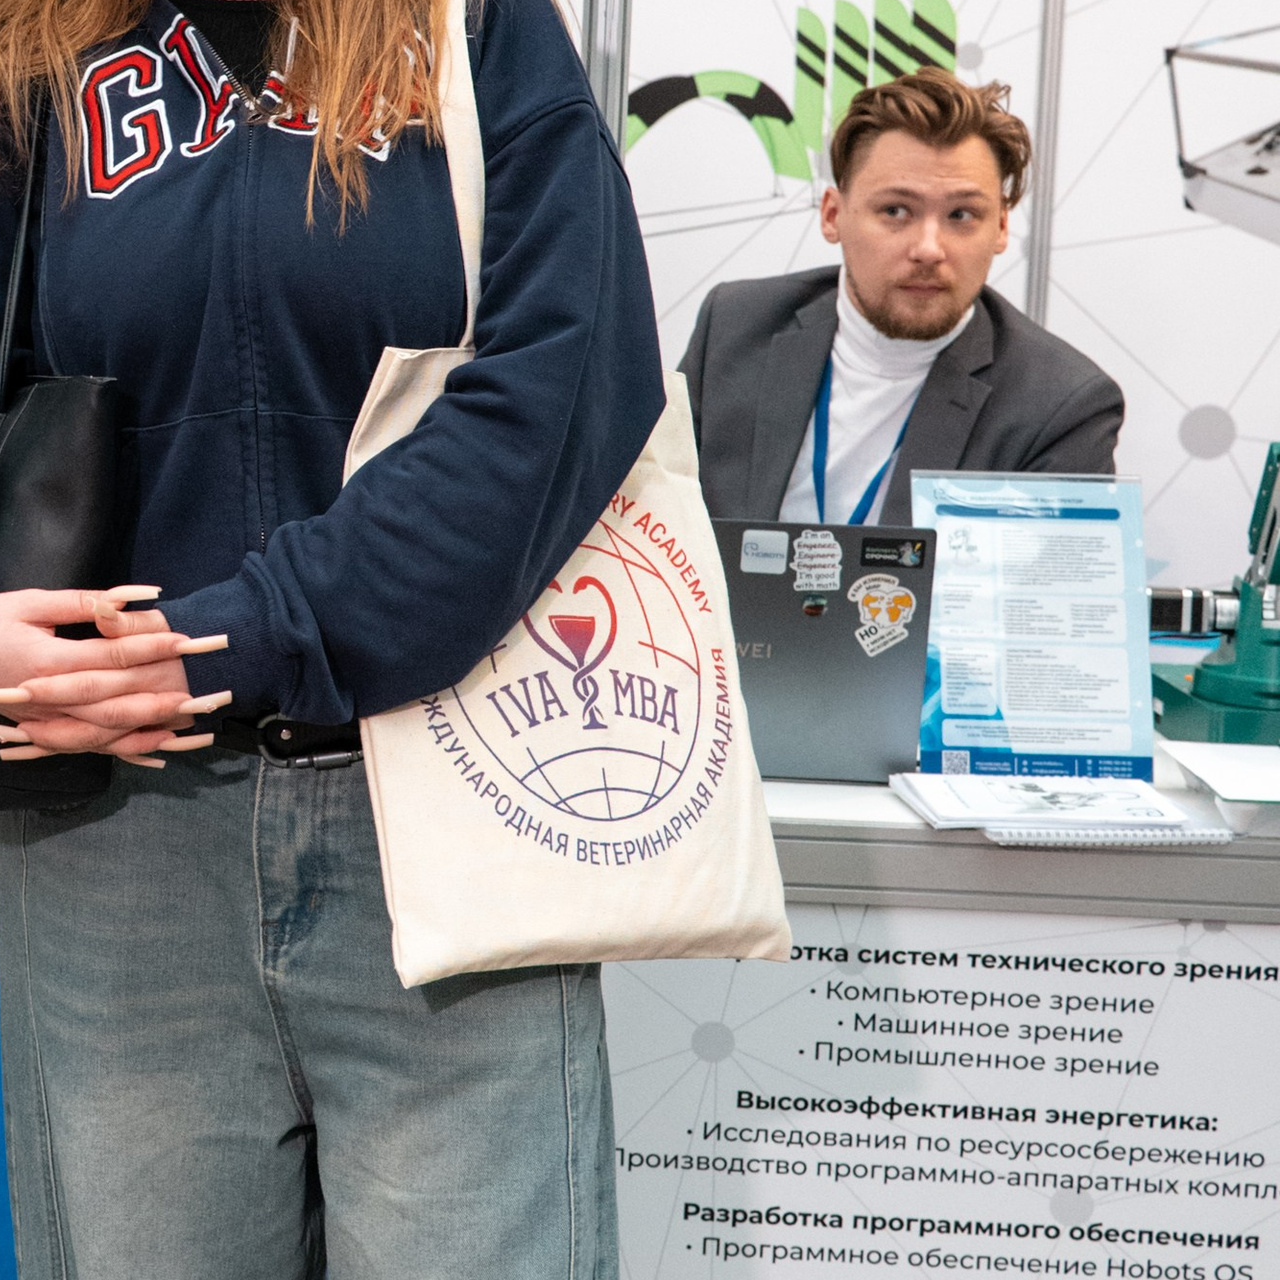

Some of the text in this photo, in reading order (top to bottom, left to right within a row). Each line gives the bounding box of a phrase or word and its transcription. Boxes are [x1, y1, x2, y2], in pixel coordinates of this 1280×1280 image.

[633, 512, 712, 615] ACADEMY
[858, 625, 878, 641] НО
[486, 671, 569, 738] IVA
[420, 648, 733, 866] ЖДУНАРОДНАЯ ВЕТЕРИНАРНАЯ АКАДЕМИЯ
[790, 946, 1278, 982] отка систем технического зрения
[827, 981, 1154, 1015] Компьютерное зрение
[854, 1013, 1123, 1044] Машинное зрение
[815, 1042, 1159, 1077] Промышленное зрение
[737, 1090, 1217, 1131] Высокоэффективная энергетика:
[703, 1122, 1265, 1168] Исследования по ресурсосбережению
[816, 1158, 1179, 1195] программно-аппаратных
[684, 1203, 1259, 1249] Разработка программного обеспечения
[702, 1237, 898, 1265] Программное
[908, 1248, 1097, 1276] обеспечение
[1107, 1258, 1205, 1280] Hobots
